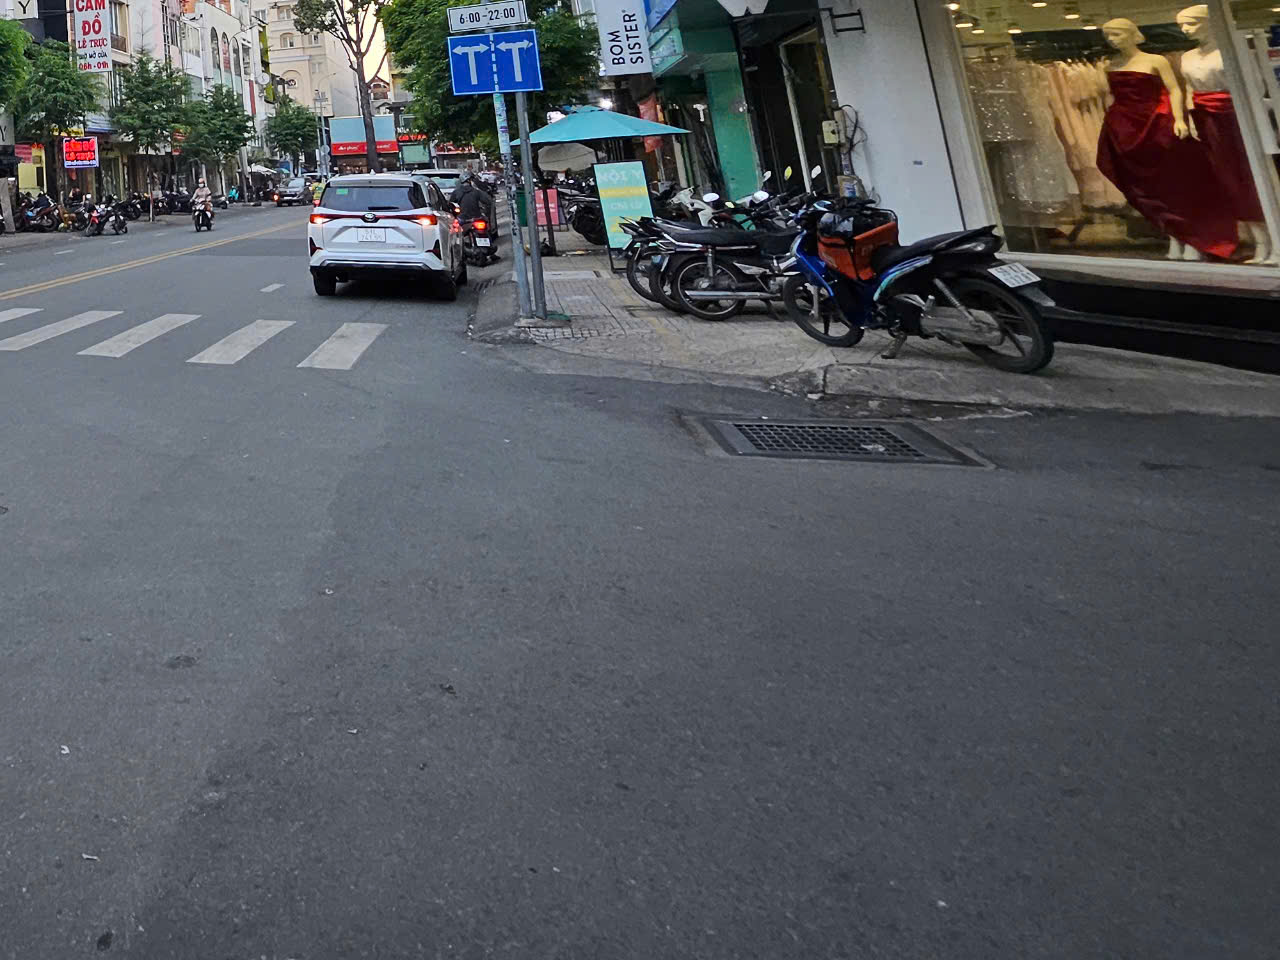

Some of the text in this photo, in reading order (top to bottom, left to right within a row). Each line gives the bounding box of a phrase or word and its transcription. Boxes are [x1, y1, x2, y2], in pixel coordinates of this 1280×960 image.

[81, 12, 102, 37] ĐỒ
[622, 12, 645, 65] SISTER
[606, 29, 626, 66] BOM
